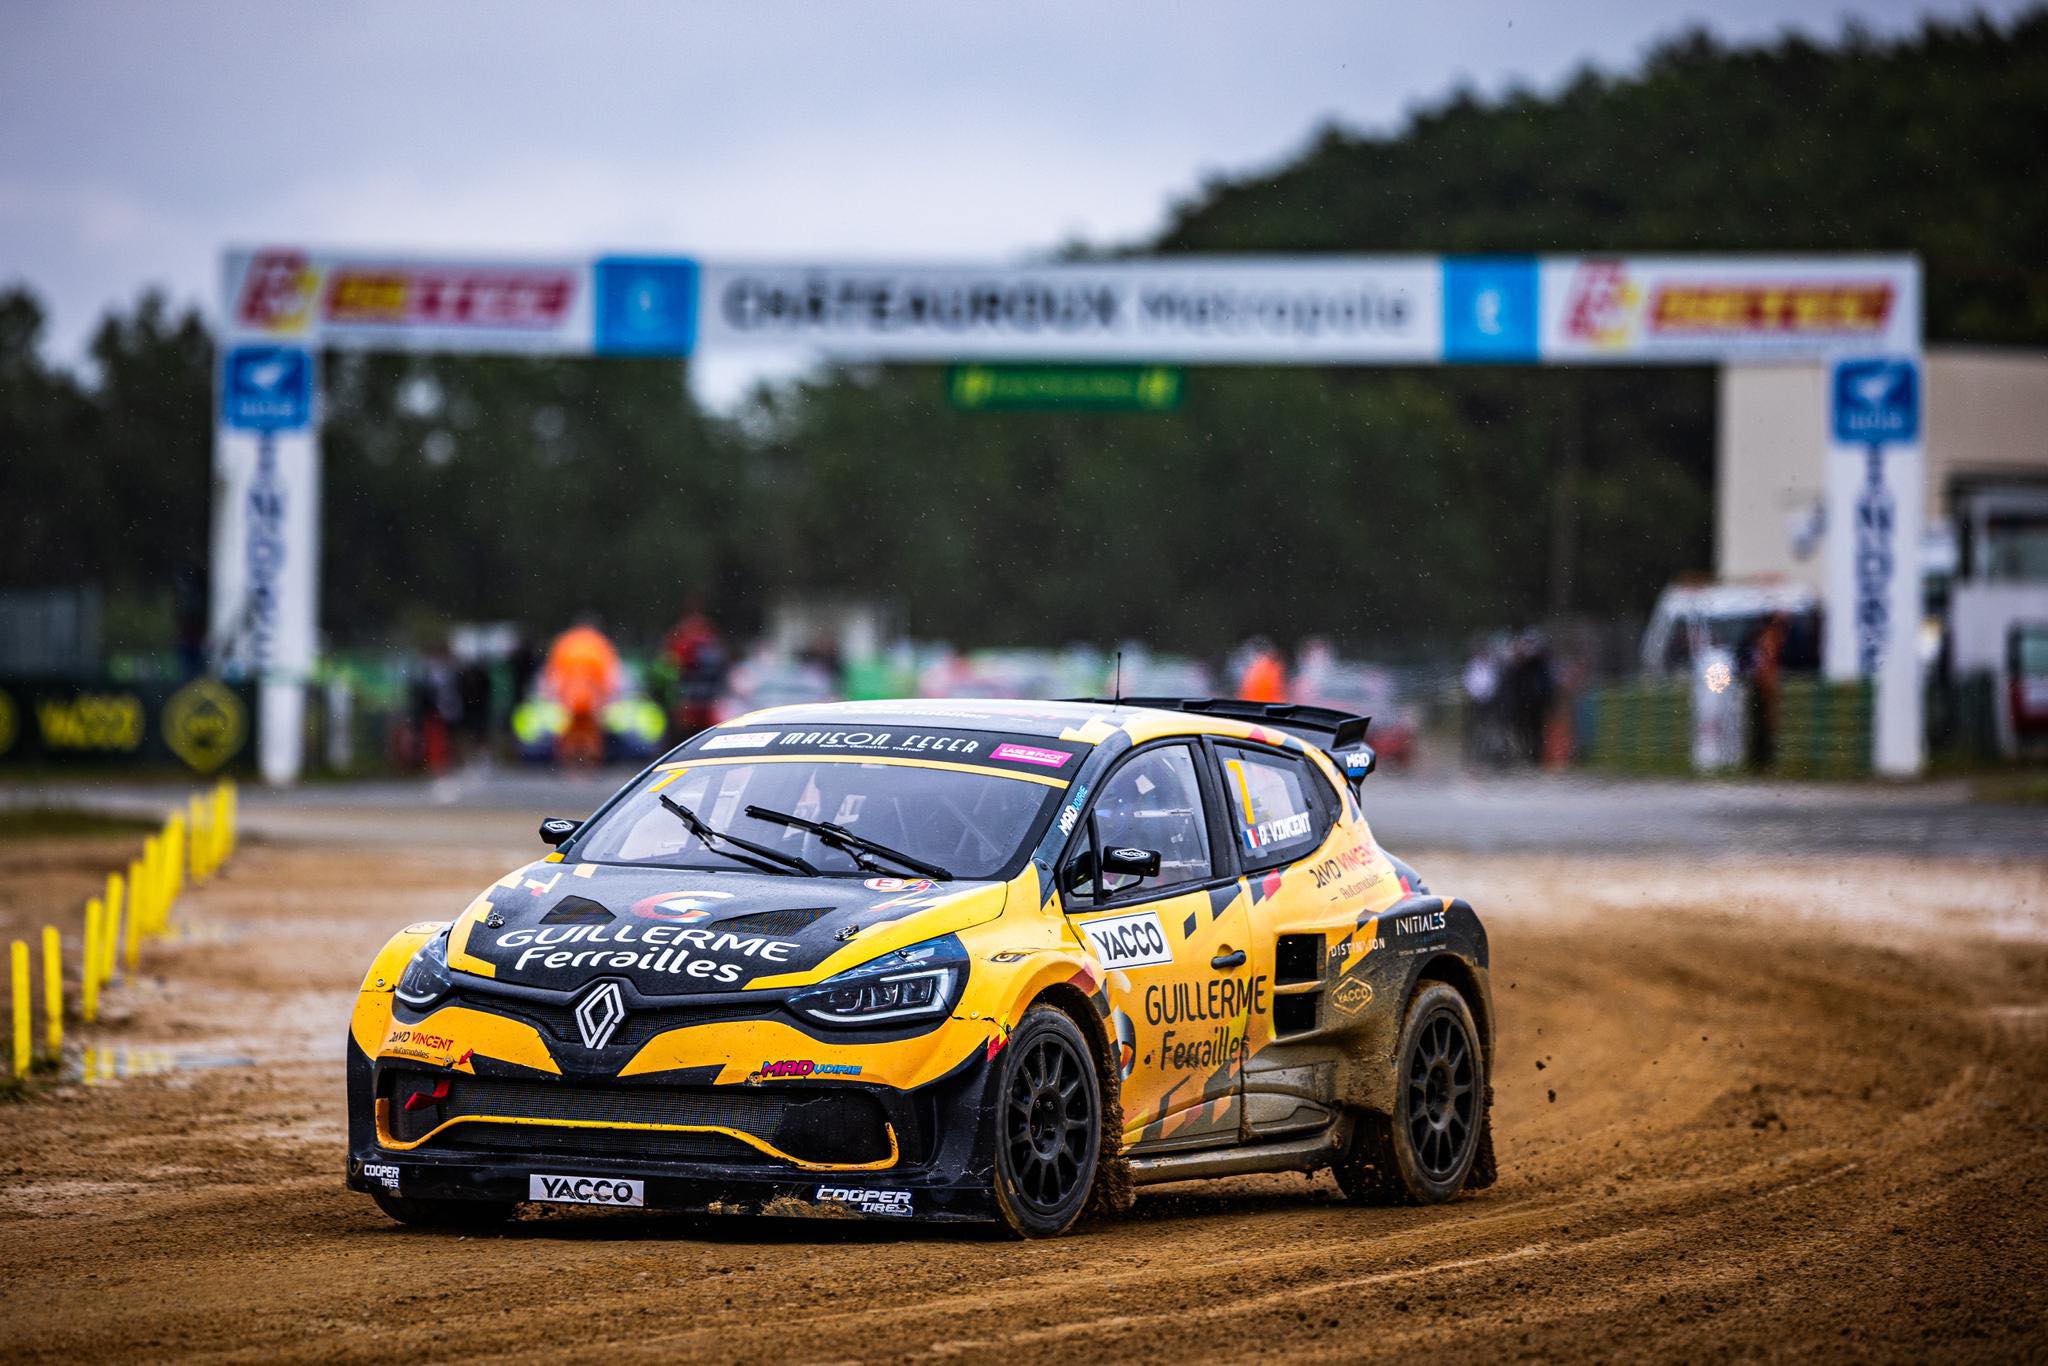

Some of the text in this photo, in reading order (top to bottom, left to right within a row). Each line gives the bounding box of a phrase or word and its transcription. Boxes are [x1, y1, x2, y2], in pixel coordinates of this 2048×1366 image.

[779, 731, 891, 747] MAISON
[901, 734, 979, 754] FEGER
[1270, 811, 1311, 843] VINCENT
[496, 923, 802, 963] GUILLERME
[1091, 920, 1164, 961] YACCO
[514, 944, 745, 983] Ferrailles
[1145, 974, 1268, 1026] GUILLERME
[1337, 986, 1369, 1003] YACCO
[411, 1031, 454, 1052] VINCENT
[1160, 1026, 1250, 1071] Ferrailles
[364, 1164, 400, 1178] COOPER
[380, 1177, 399, 1188] TIRES
[540, 1176, 634, 1203] YACCO
[816, 1187, 912, 1204] COOPER
[861, 1202, 908, 1214] TIRES
